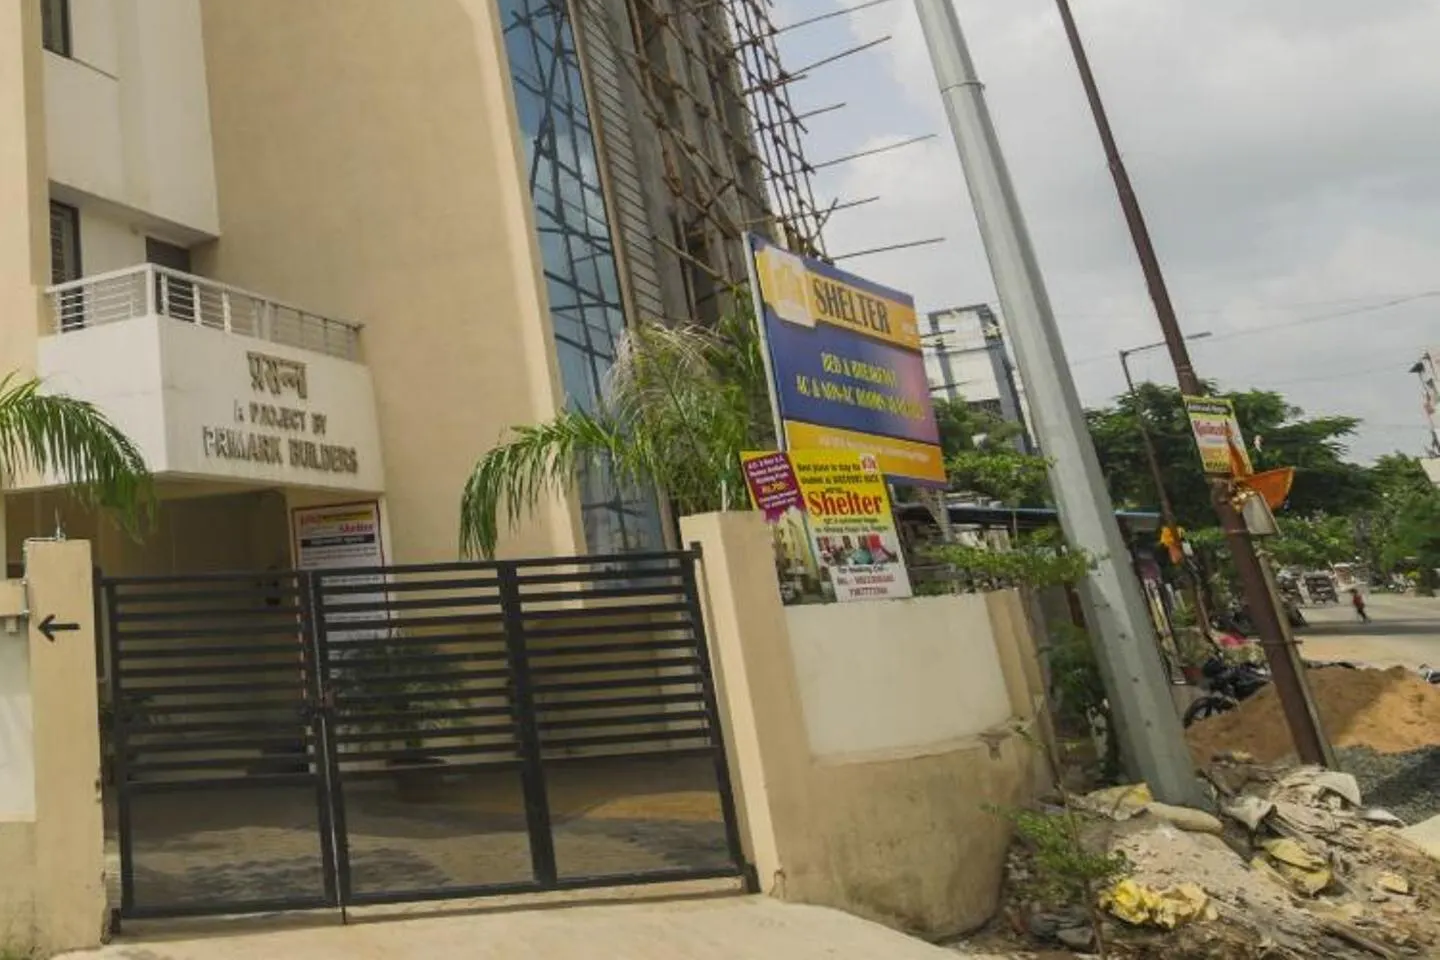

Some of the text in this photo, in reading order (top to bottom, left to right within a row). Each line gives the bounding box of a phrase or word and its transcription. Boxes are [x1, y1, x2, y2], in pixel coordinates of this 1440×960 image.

[812, 278, 891, 335] SHELTER
[249, 401, 306, 432] PROJECT
[287, 437, 358, 474] BUILDERS
[809, 490, 883, 517] Shelter
